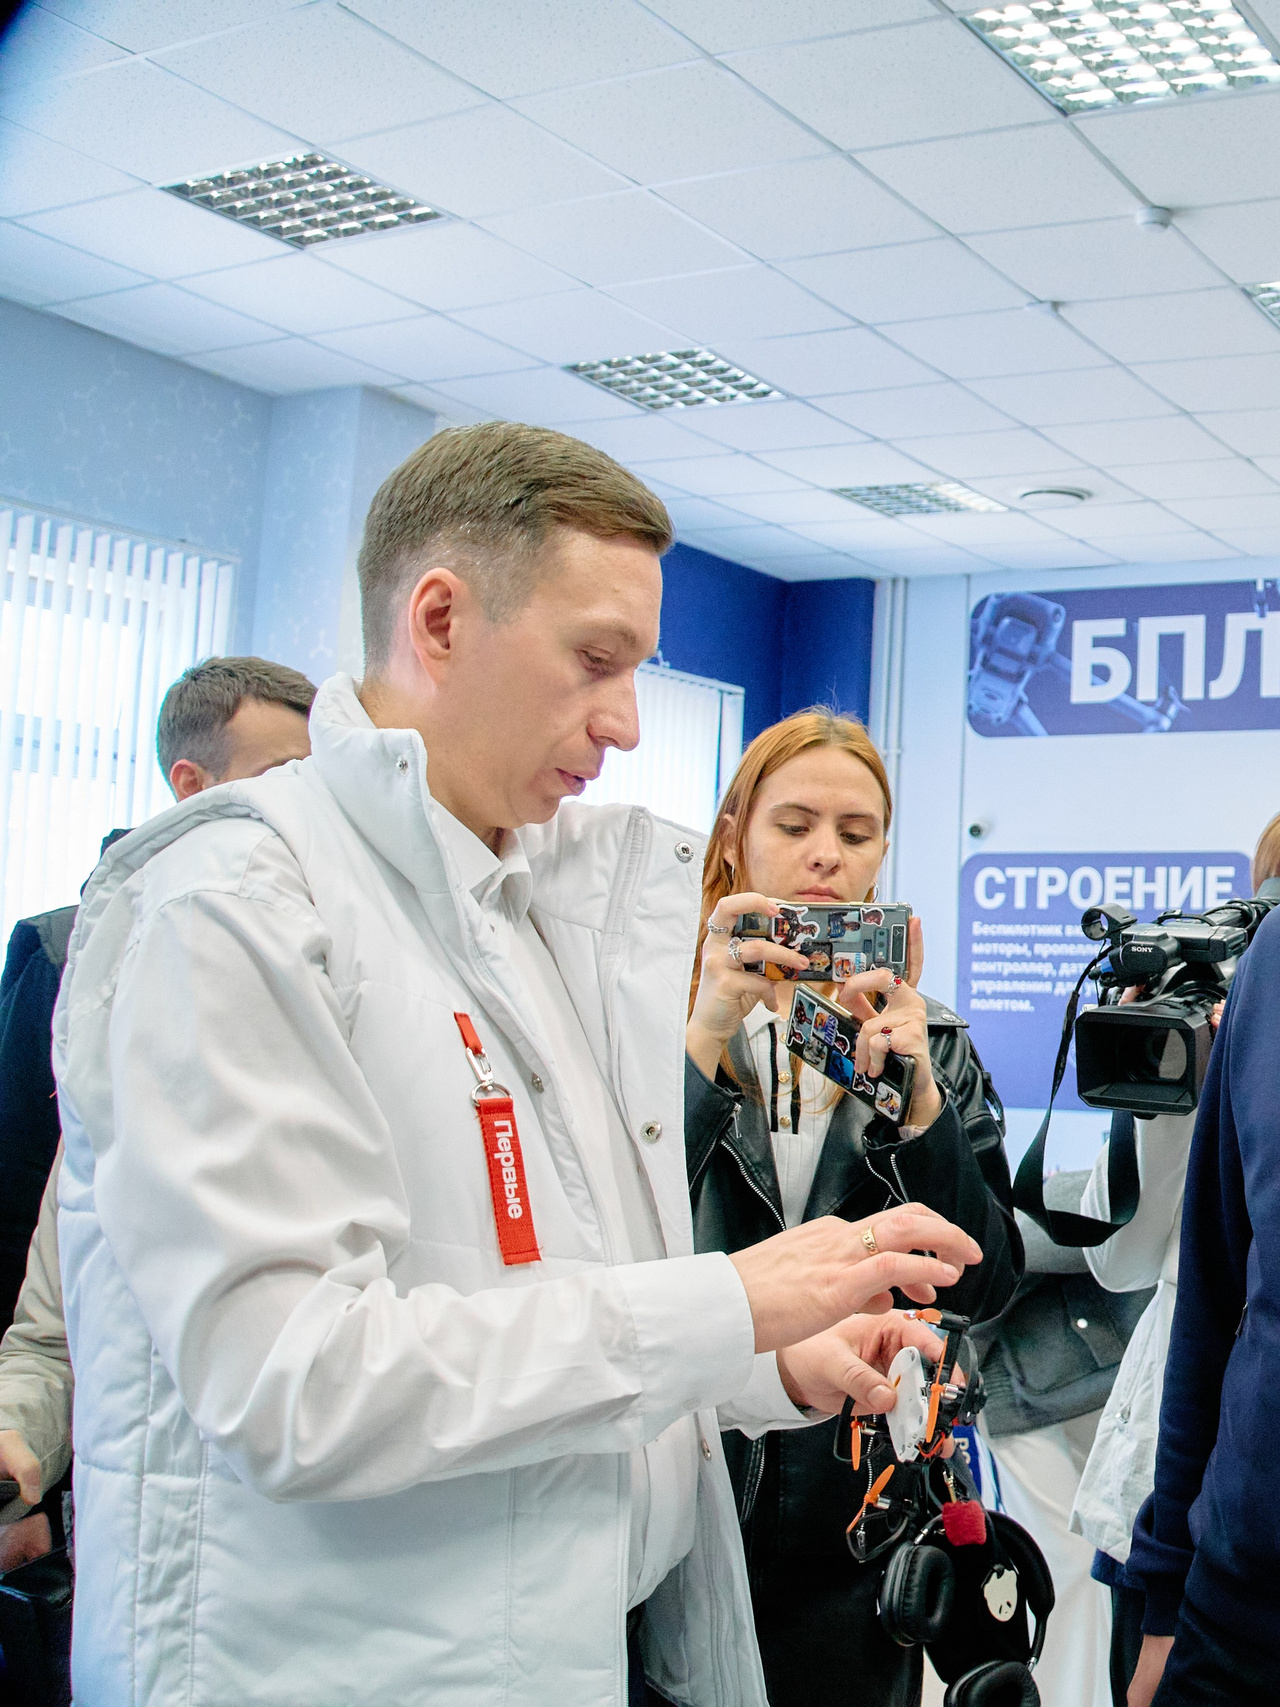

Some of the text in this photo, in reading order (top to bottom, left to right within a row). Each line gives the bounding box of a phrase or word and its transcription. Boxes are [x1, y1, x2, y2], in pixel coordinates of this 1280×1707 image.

[973, 865, 1236, 911] СТРОЕНИЕ
[971, 921, 1064, 937] Беспилотник
[971, 942, 1032, 958] моторы,
[1131, 945, 1153, 953] SONY
[970, 961, 1057, 978] контроллер,
[970, 980, 1053, 995] управления
[969, 998, 1035, 1012] полетом.
[493, 1119, 523, 1219] Первые
